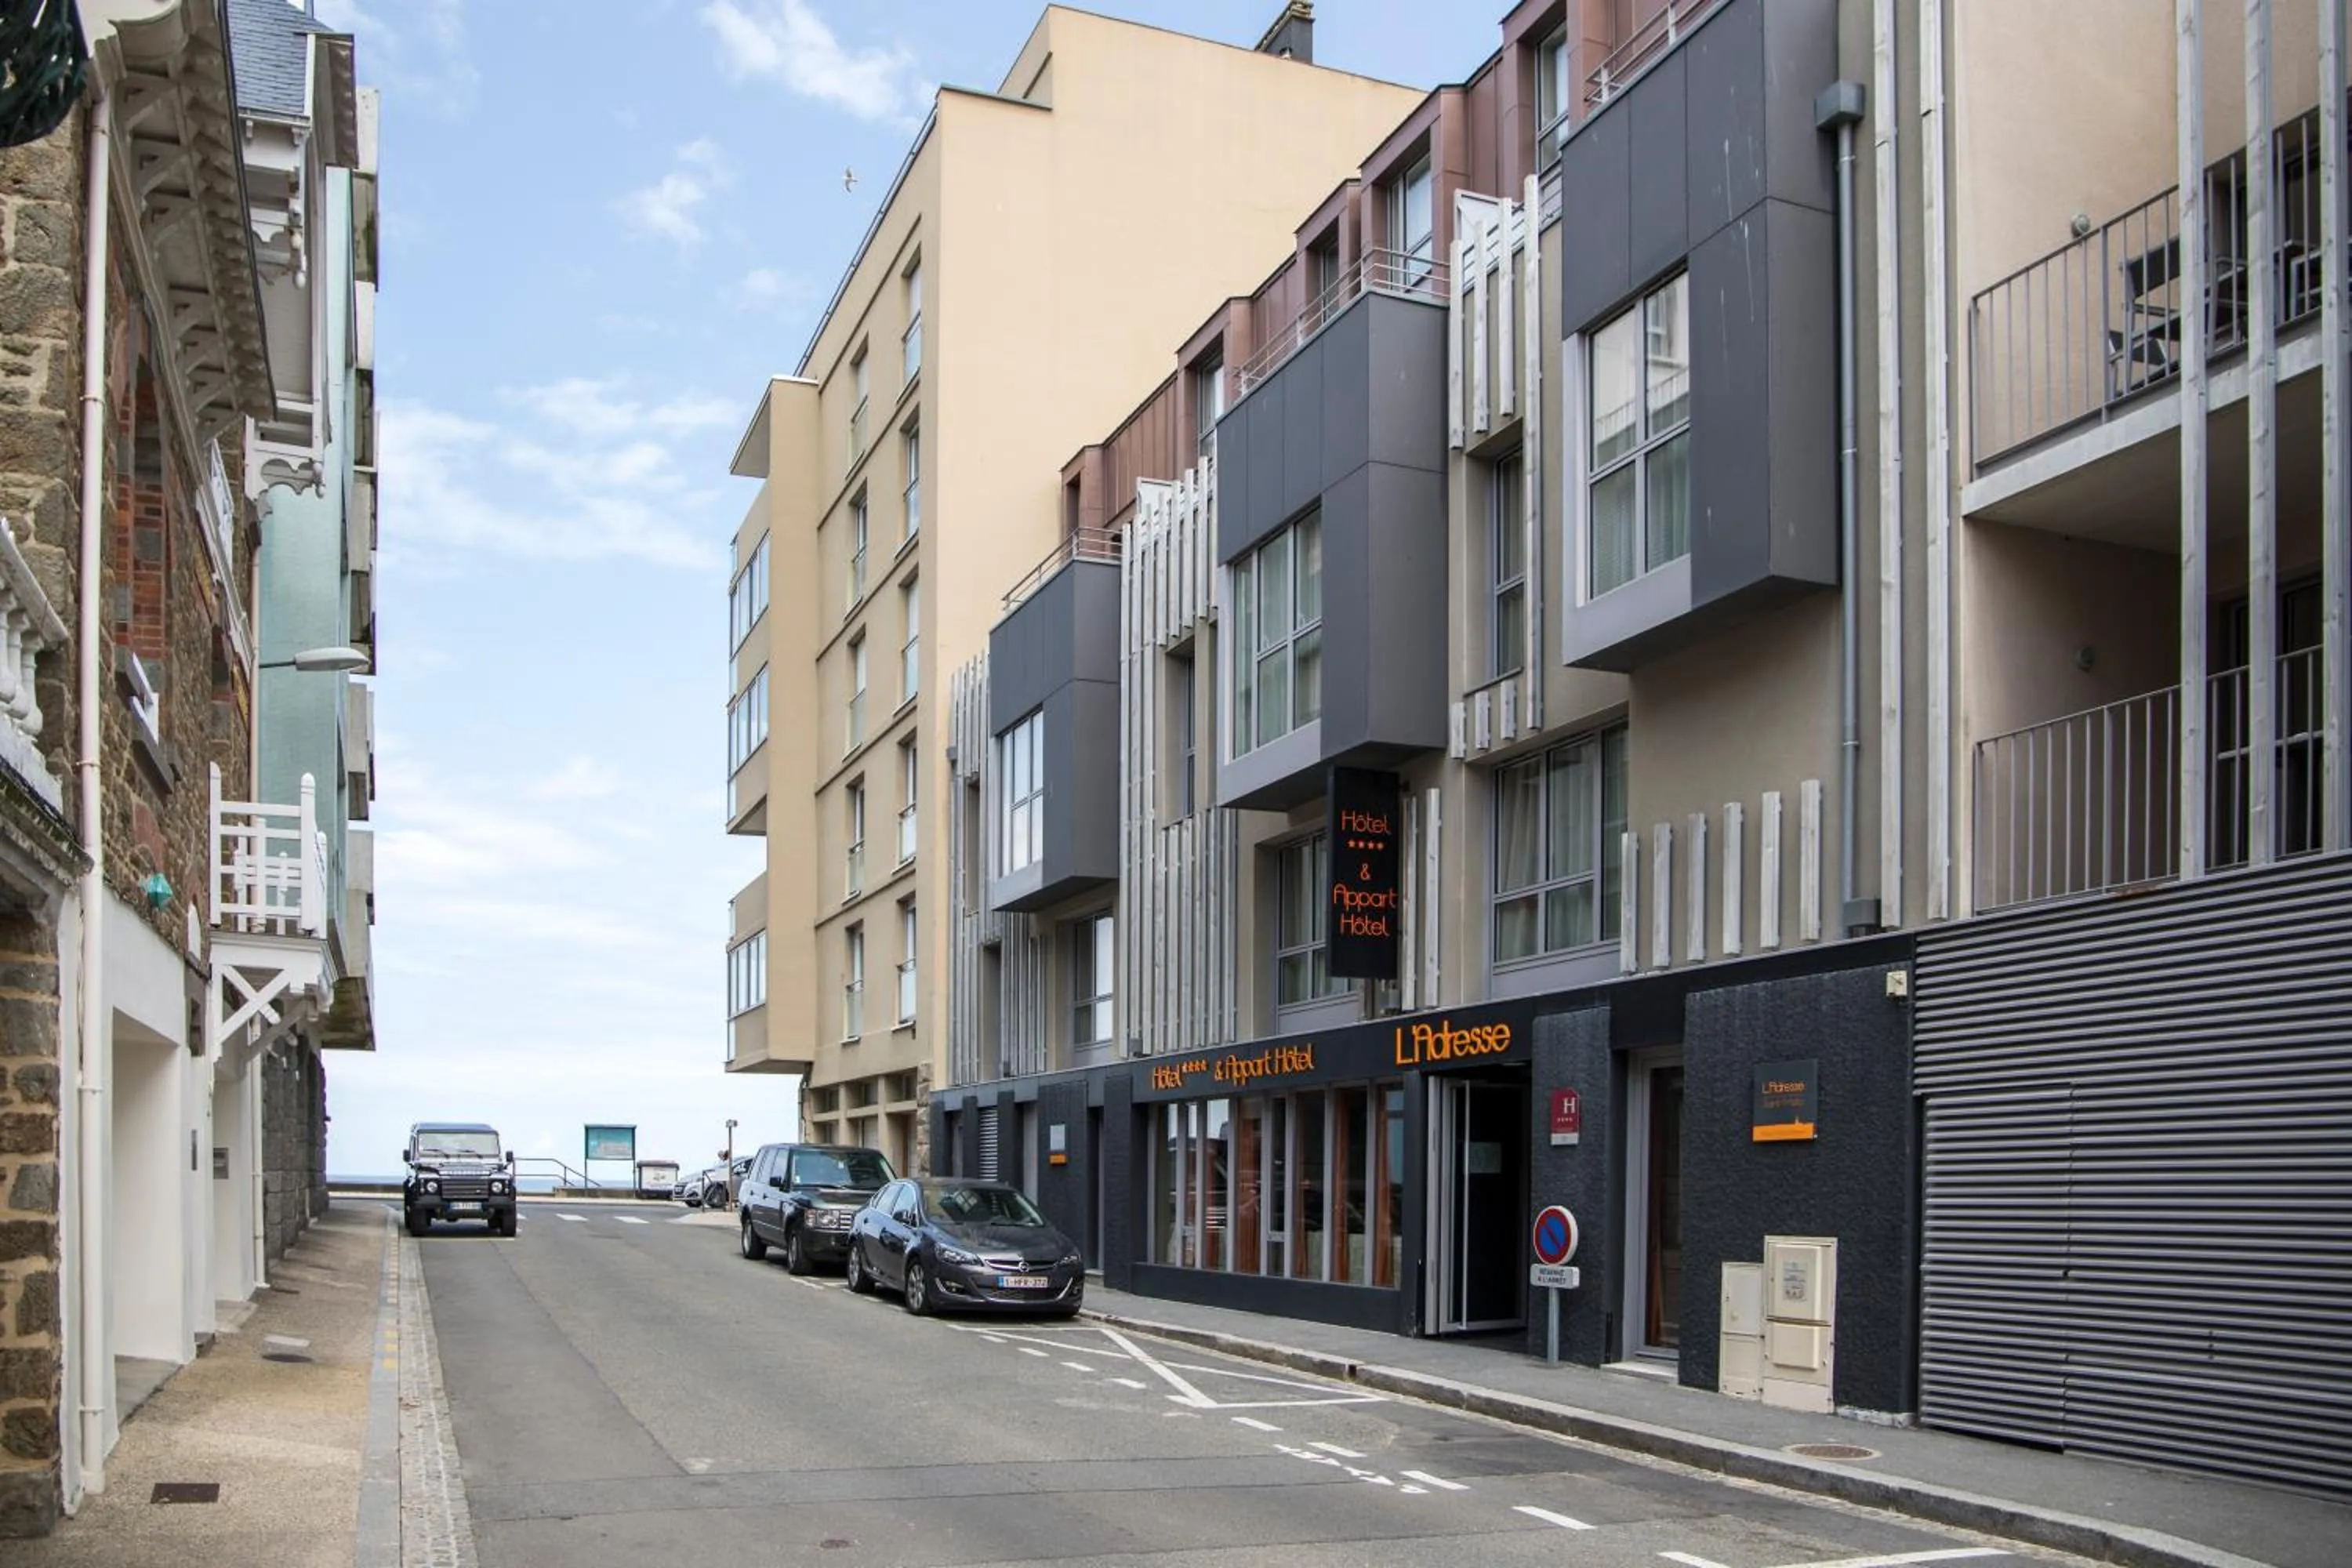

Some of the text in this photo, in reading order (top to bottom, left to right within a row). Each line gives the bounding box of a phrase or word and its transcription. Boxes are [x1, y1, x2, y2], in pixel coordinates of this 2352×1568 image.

[1341, 810, 1391, 835] Hôtel
[1360, 863, 1371, 881] &
[1334, 884, 1398, 913] Appart
[1340, 913, 1390, 936] Hôtel
[1396, 1020, 1512, 1065] L'Adresse
[1152, 1042, 1316, 1091] Hôtel & Appart Hôtel
[1563, 1097, 1576, 1114] H
